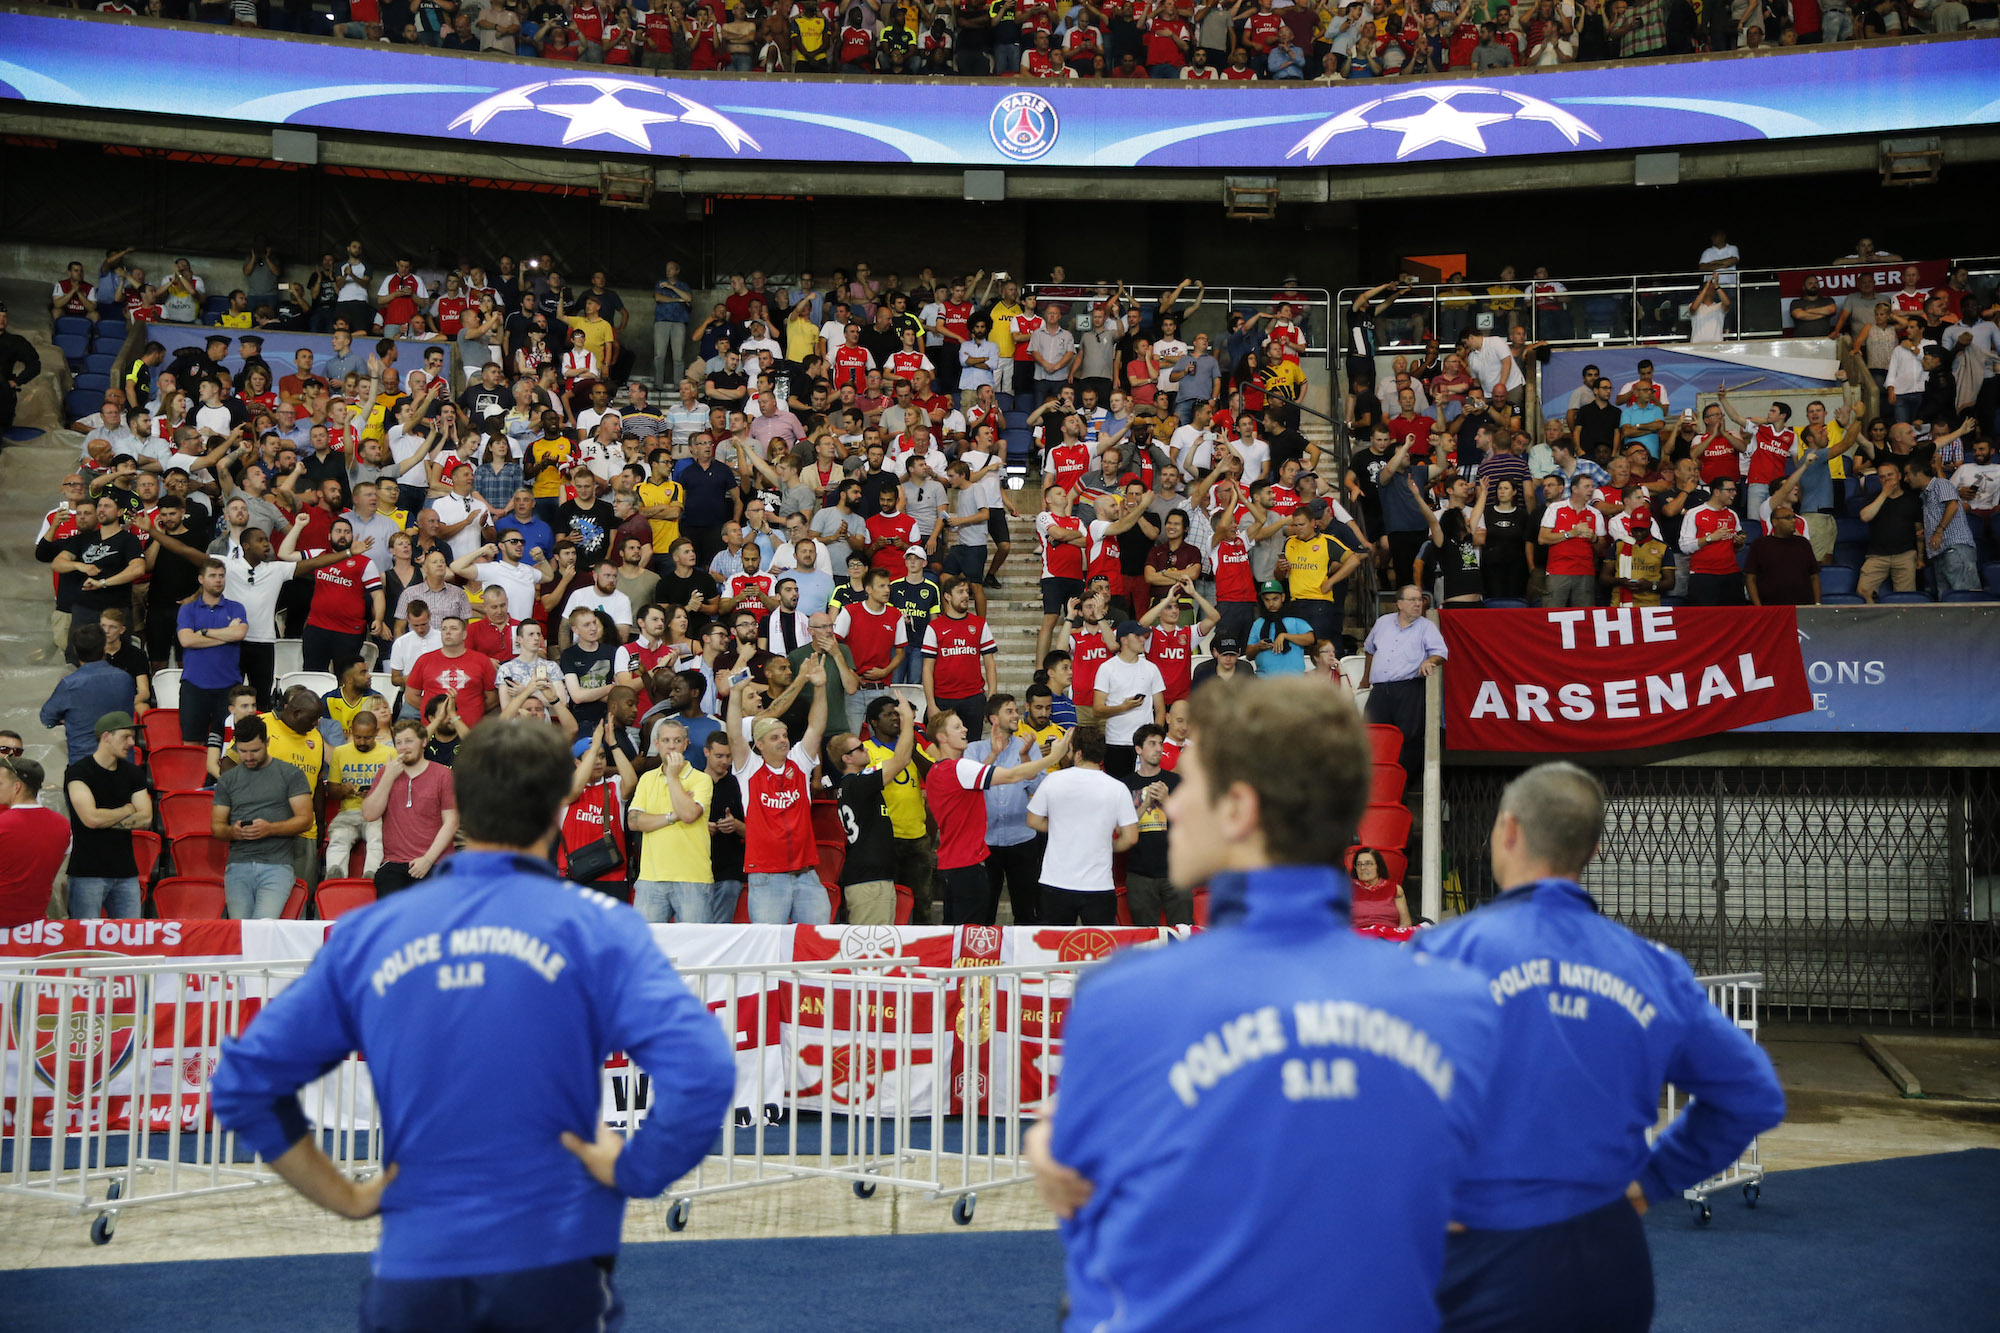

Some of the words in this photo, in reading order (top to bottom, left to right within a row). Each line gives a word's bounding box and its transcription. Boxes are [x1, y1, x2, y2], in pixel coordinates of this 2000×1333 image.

[1001, 95, 1047, 114] PARIS
[1816, 270, 1902, 289] GUNER
[586, 446, 597, 457] 14
[1704, 448, 1734, 457] Emirates
[1760, 442, 1789, 457] Emirates
[1058, 463, 1084, 473] Emirates
[330, 567, 342, 575] Fly
[1290, 562, 1319, 571] mirates
[317, 570, 353, 587] Emirates
[1548, 606, 1677, 649] THE
[953, 638, 966, 647] Fly
[941, 646, 977, 657] Emirates
[1082, 647, 1107, 661] JVC
[1159, 648, 1185, 660] JVC
[1469, 653, 1775, 723] ARSENAL
[292, 753, 304, 762] Fly
[588, 803, 603, 814] Fly
[838, 803, 860, 842] 3
[79, 919, 182, 946] Tours
[370, 932, 443, 997] POLICE
[450, 926, 567, 983] NATIONALE
[1489, 958, 1551, 1008] POLICE
[1558, 960, 1658, 1030] NATIONALE
[1169, 1005, 1288, 1107] POLICE
[1293, 999, 1454, 1102] NATIONALE
